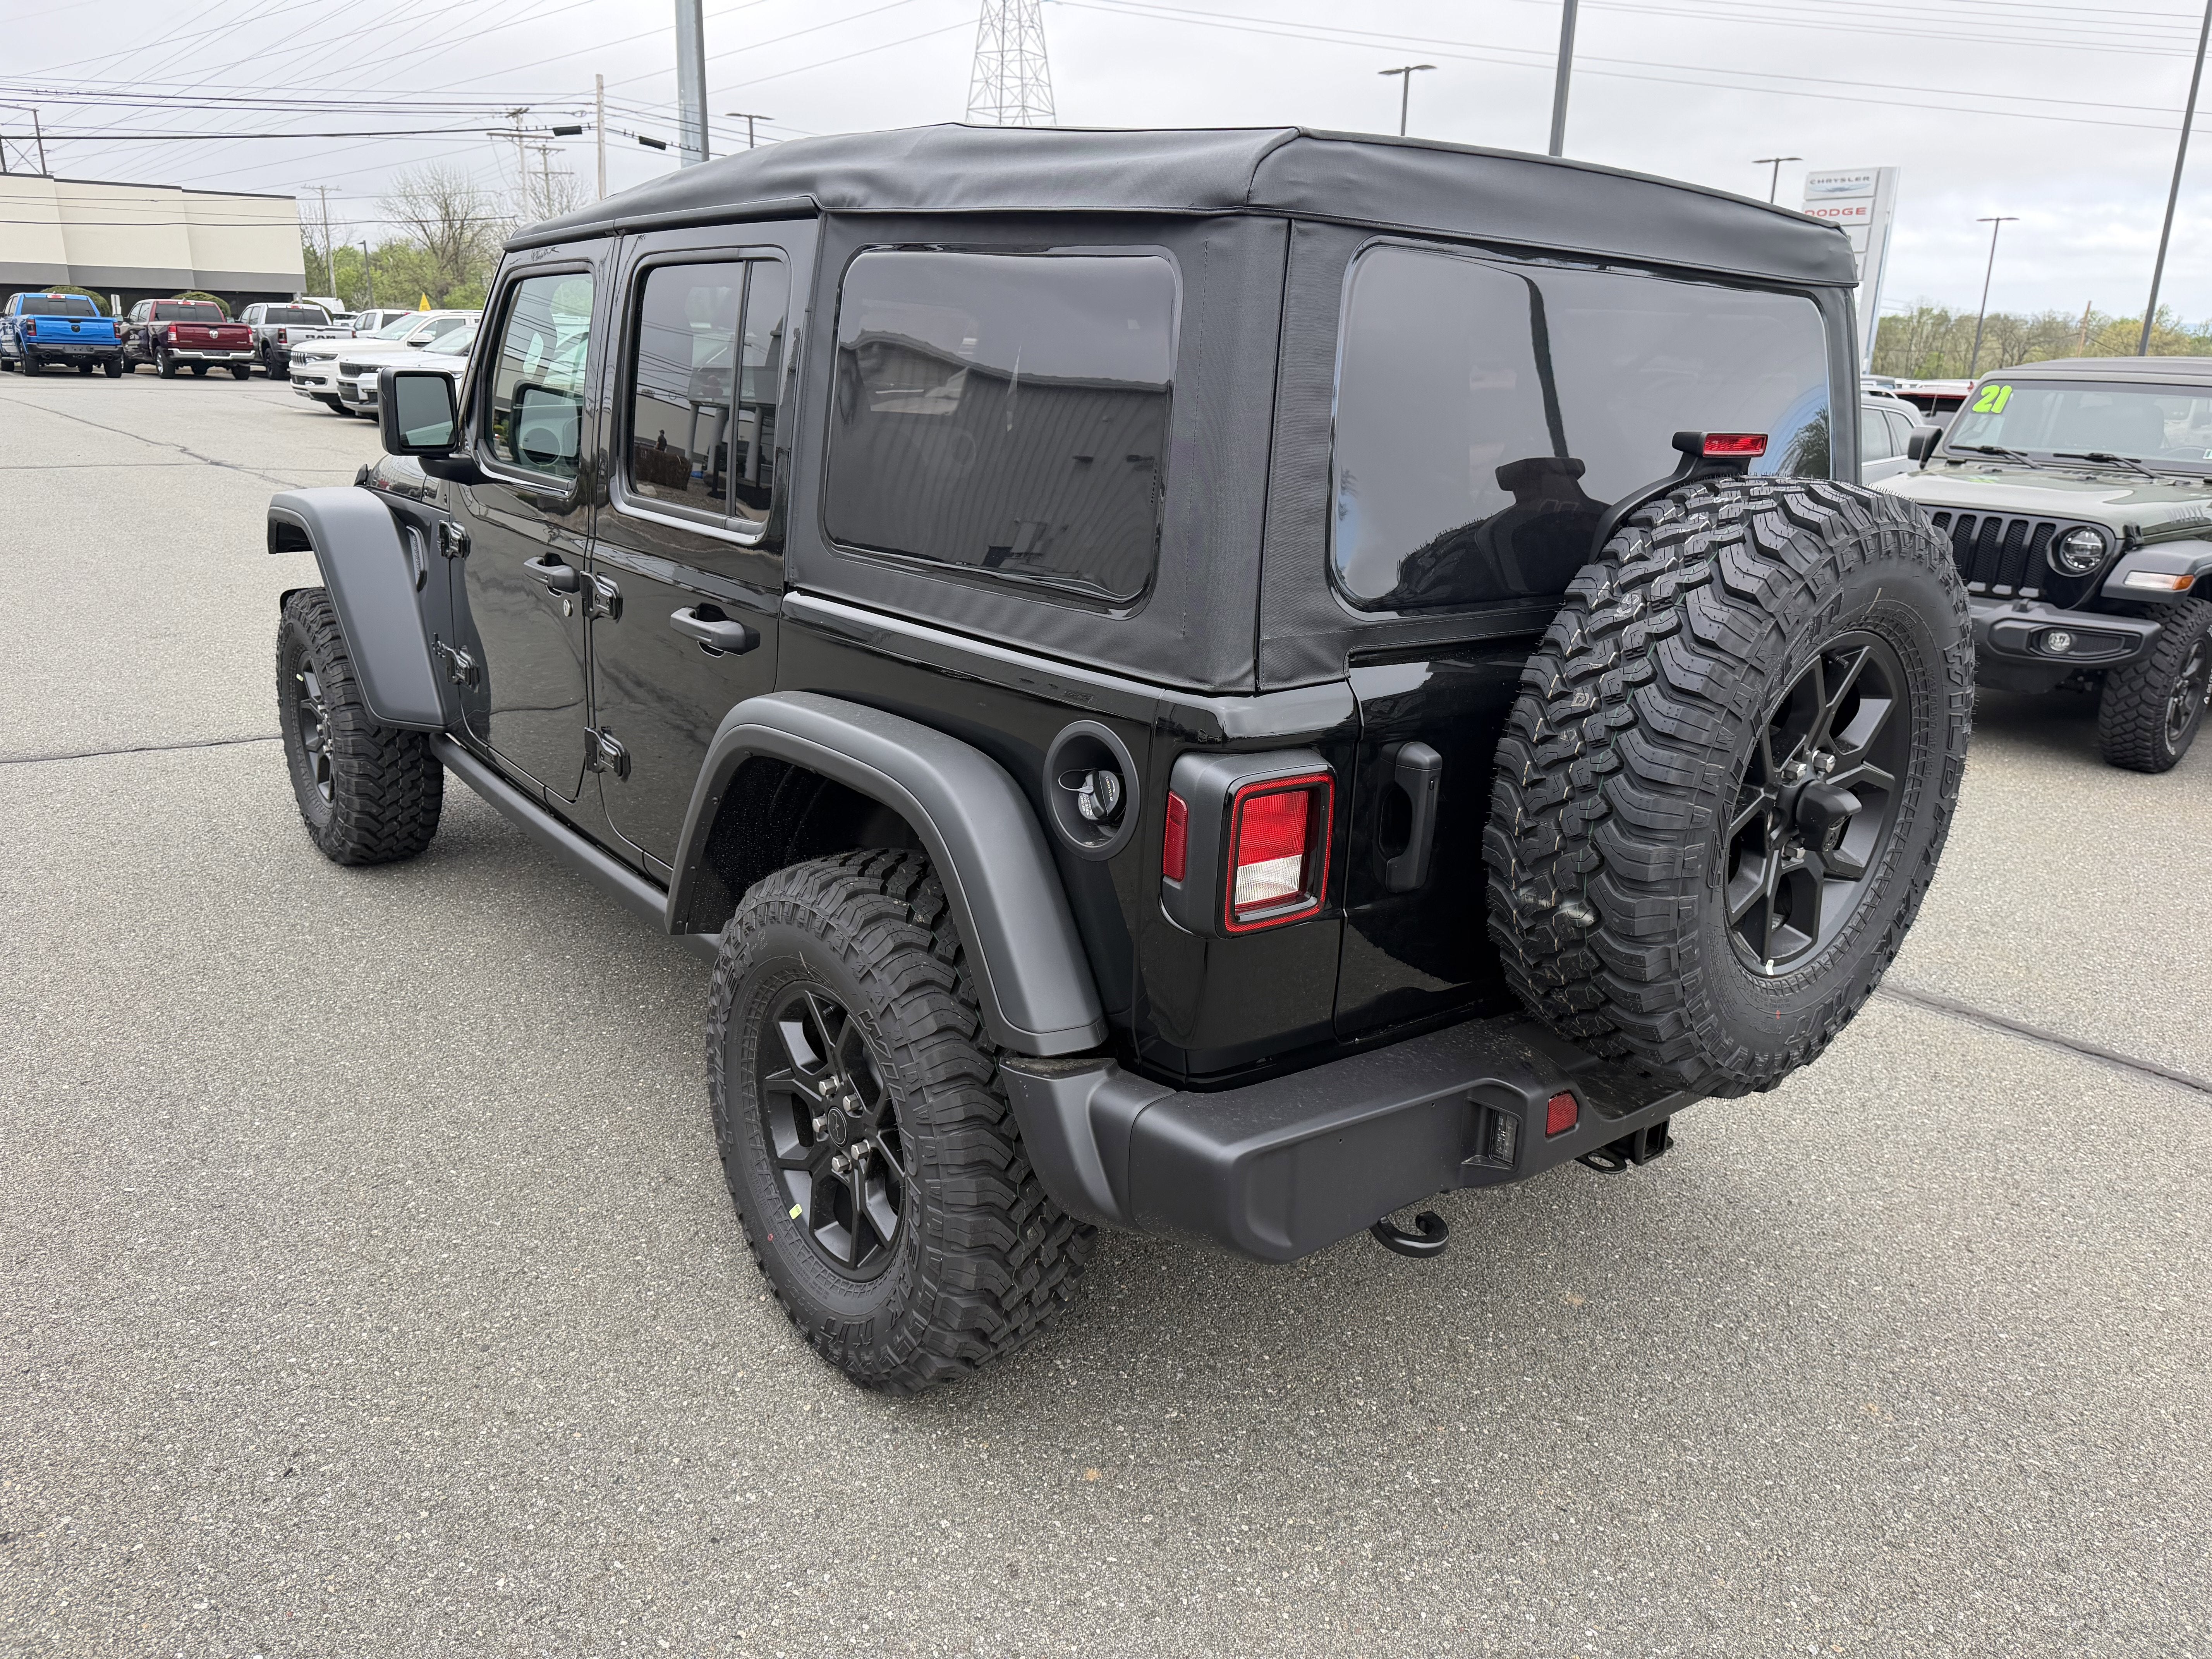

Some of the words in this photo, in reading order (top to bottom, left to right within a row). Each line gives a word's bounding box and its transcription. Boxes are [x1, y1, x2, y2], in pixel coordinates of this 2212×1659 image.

[1810, 176, 1870, 185] CHRYSLER
[1805, 207, 1867, 216] DODGE
[1972, 385, 2012, 413] 21
